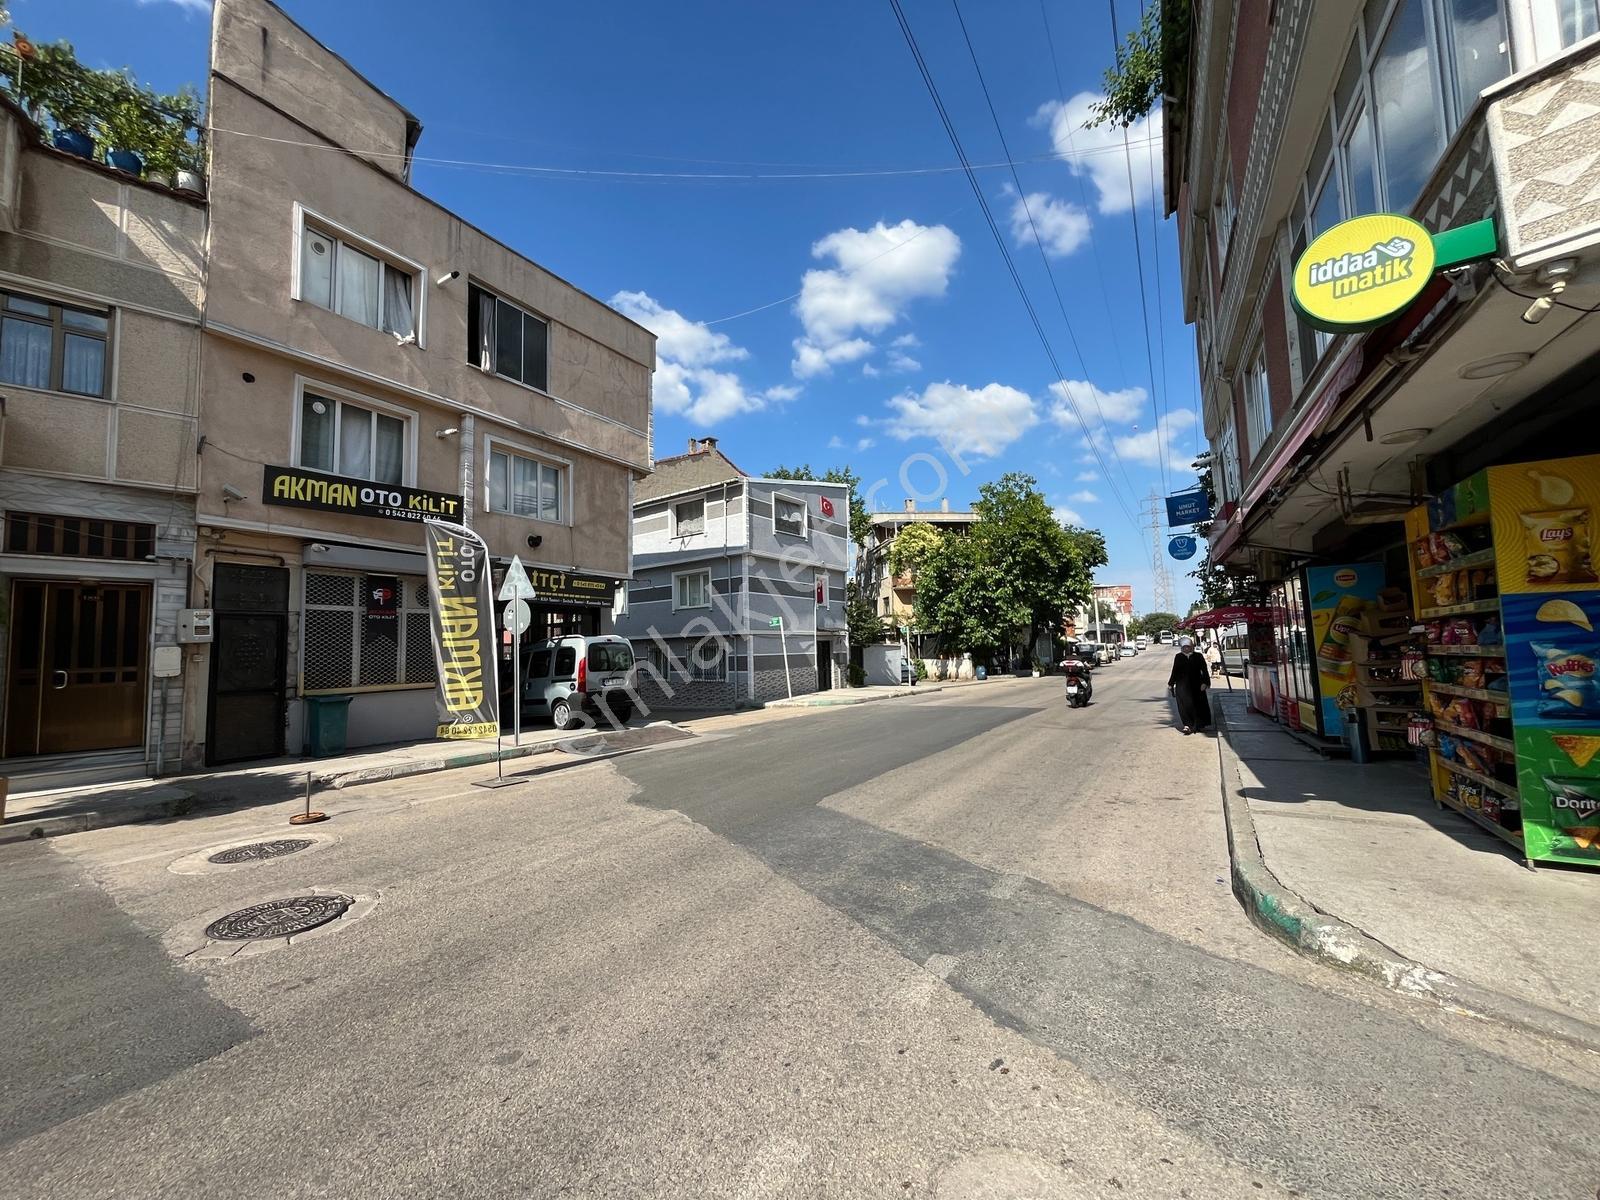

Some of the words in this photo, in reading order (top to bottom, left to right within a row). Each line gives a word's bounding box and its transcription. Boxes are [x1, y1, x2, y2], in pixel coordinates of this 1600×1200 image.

[1310, 249, 1378, 285] iddaa
[1334, 258, 1410, 298] matik
[273, 475, 358, 508] AKMAN
[360, 487, 402, 507] OTO
[392, 510, 406, 518] 542
[407, 512, 421, 520] 822
[1176, 507, 1200, 517] MARKET
[532, 570, 566, 591] İTÇİ
